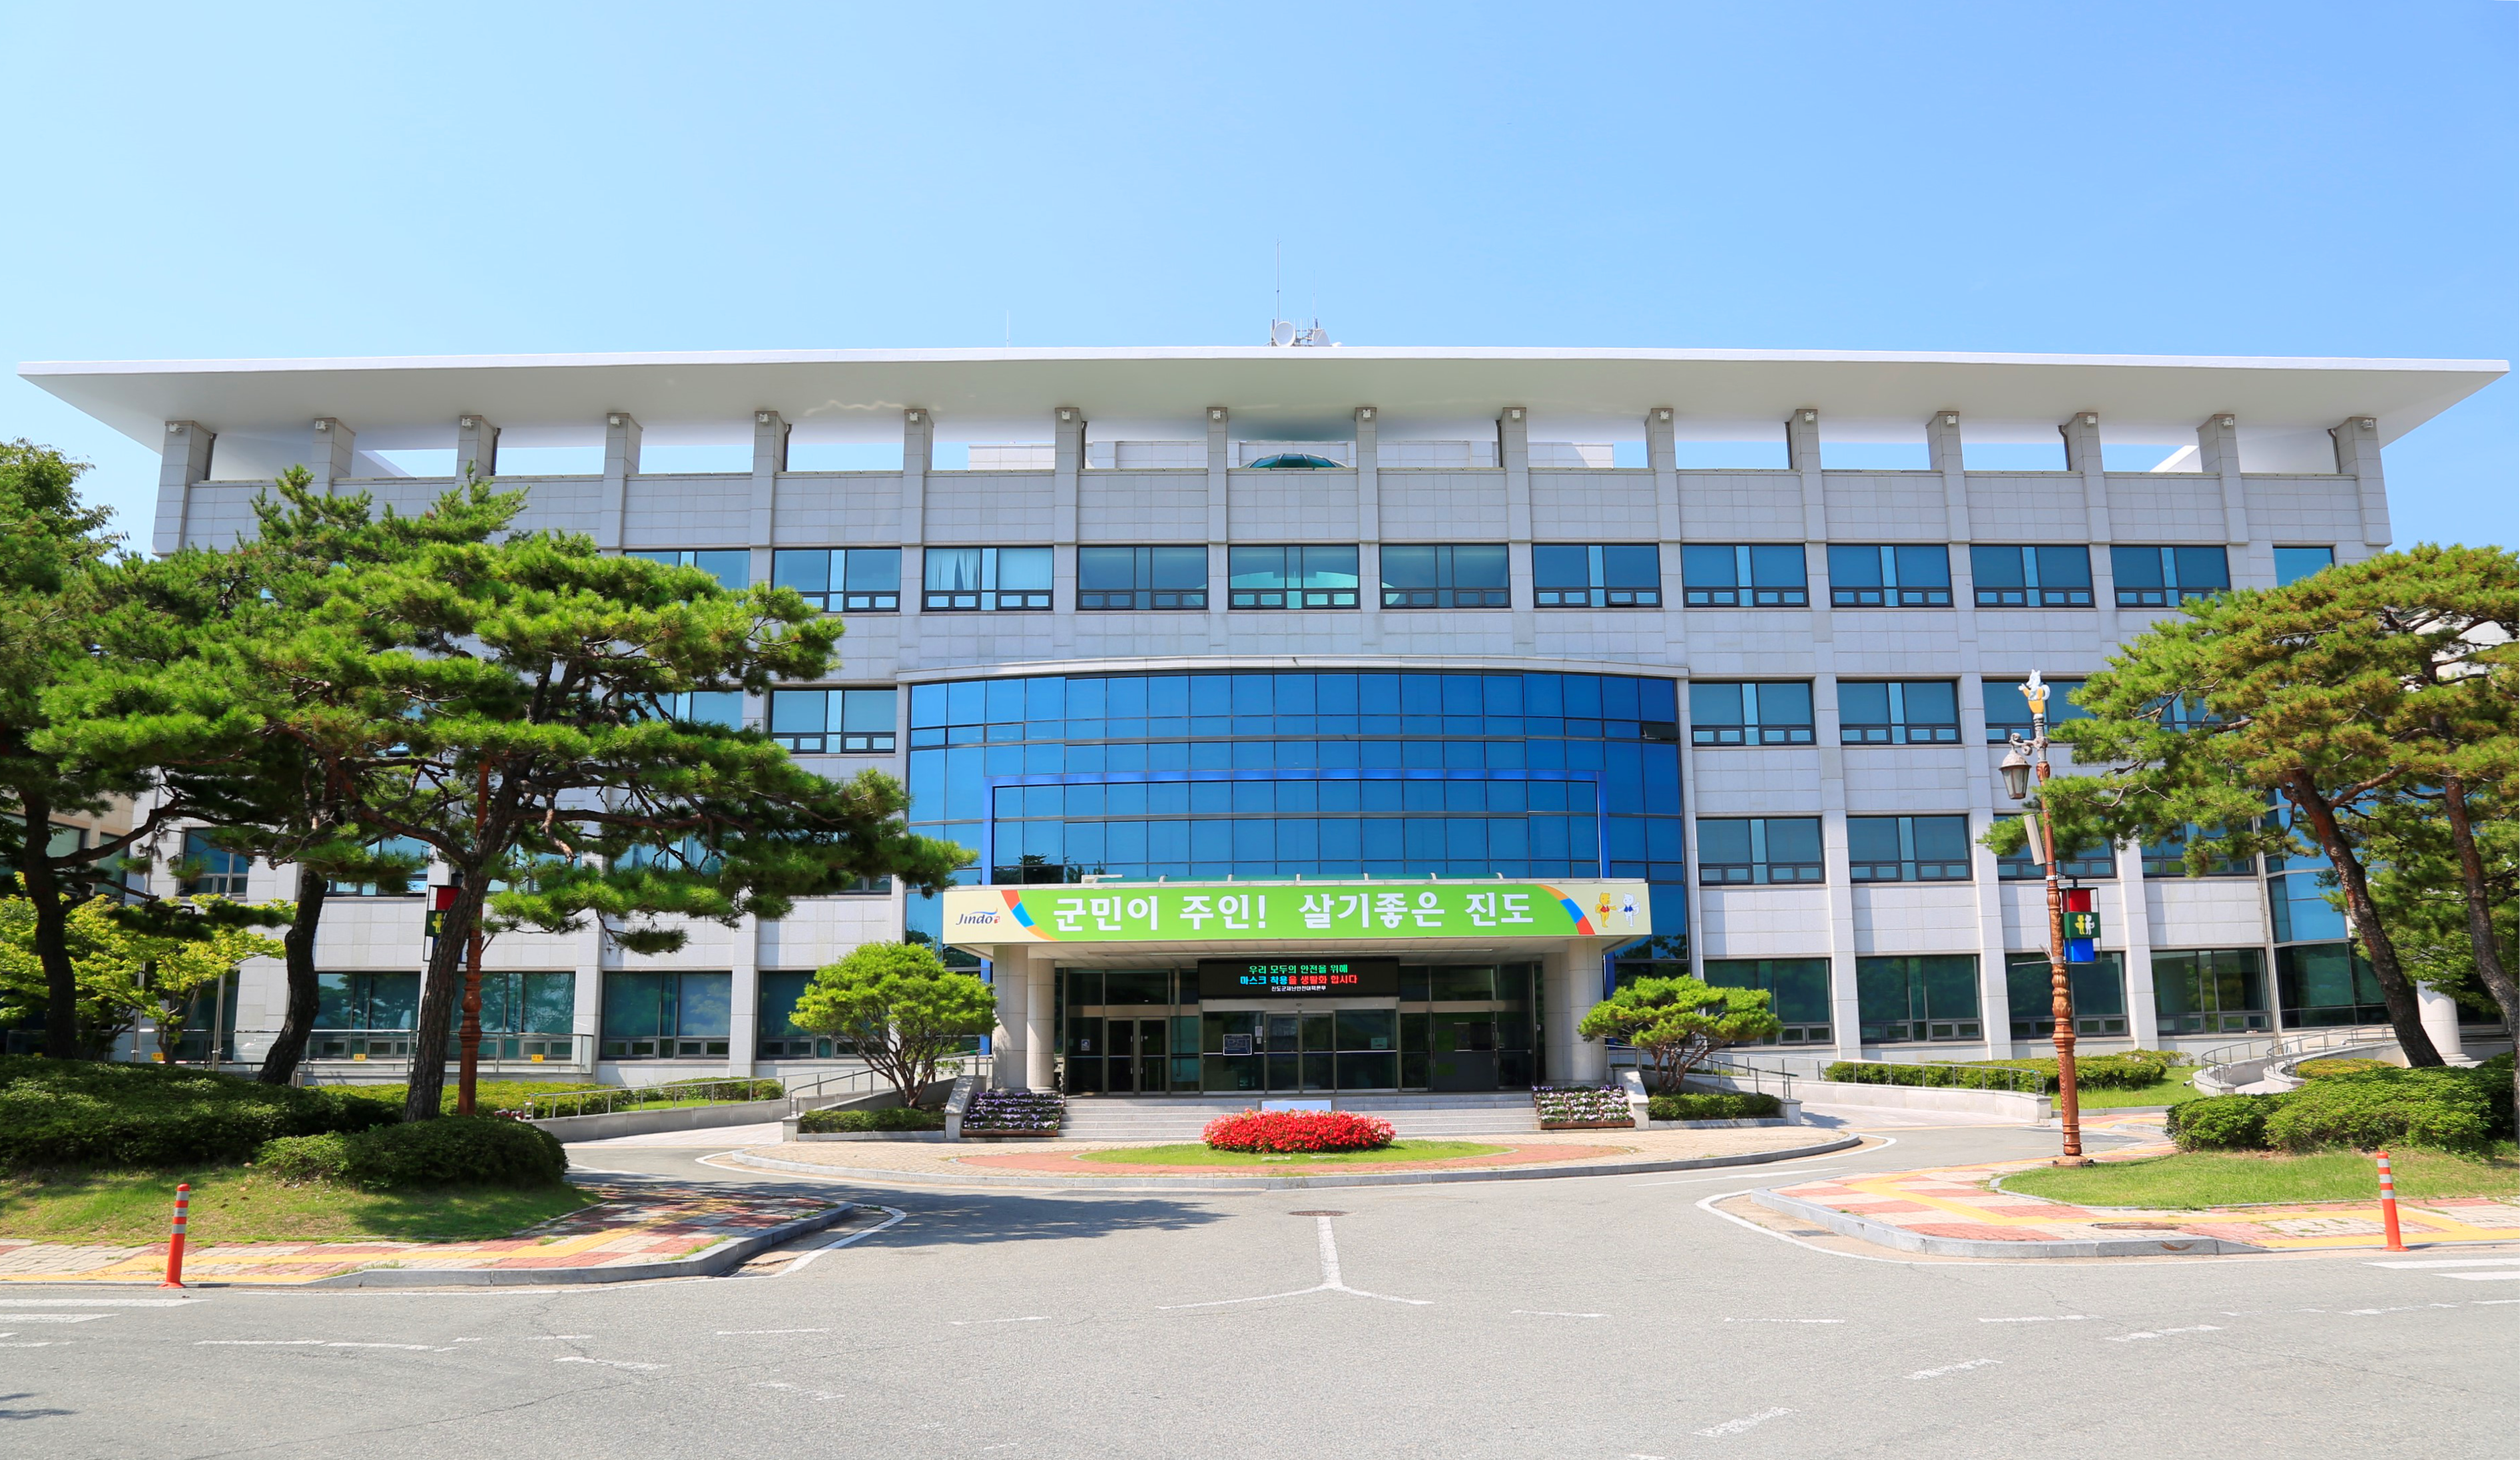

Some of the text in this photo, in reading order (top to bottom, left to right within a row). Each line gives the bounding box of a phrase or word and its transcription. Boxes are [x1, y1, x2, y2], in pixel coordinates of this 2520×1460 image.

[1053, 891, 1534, 931] 군민이 주인! 살기좋은 진도
[1249, 964, 1348, 974] 우리 모두의 안전을 위해
[1240, 974, 1358, 985] 마스크 착용을 생활화 합시다
